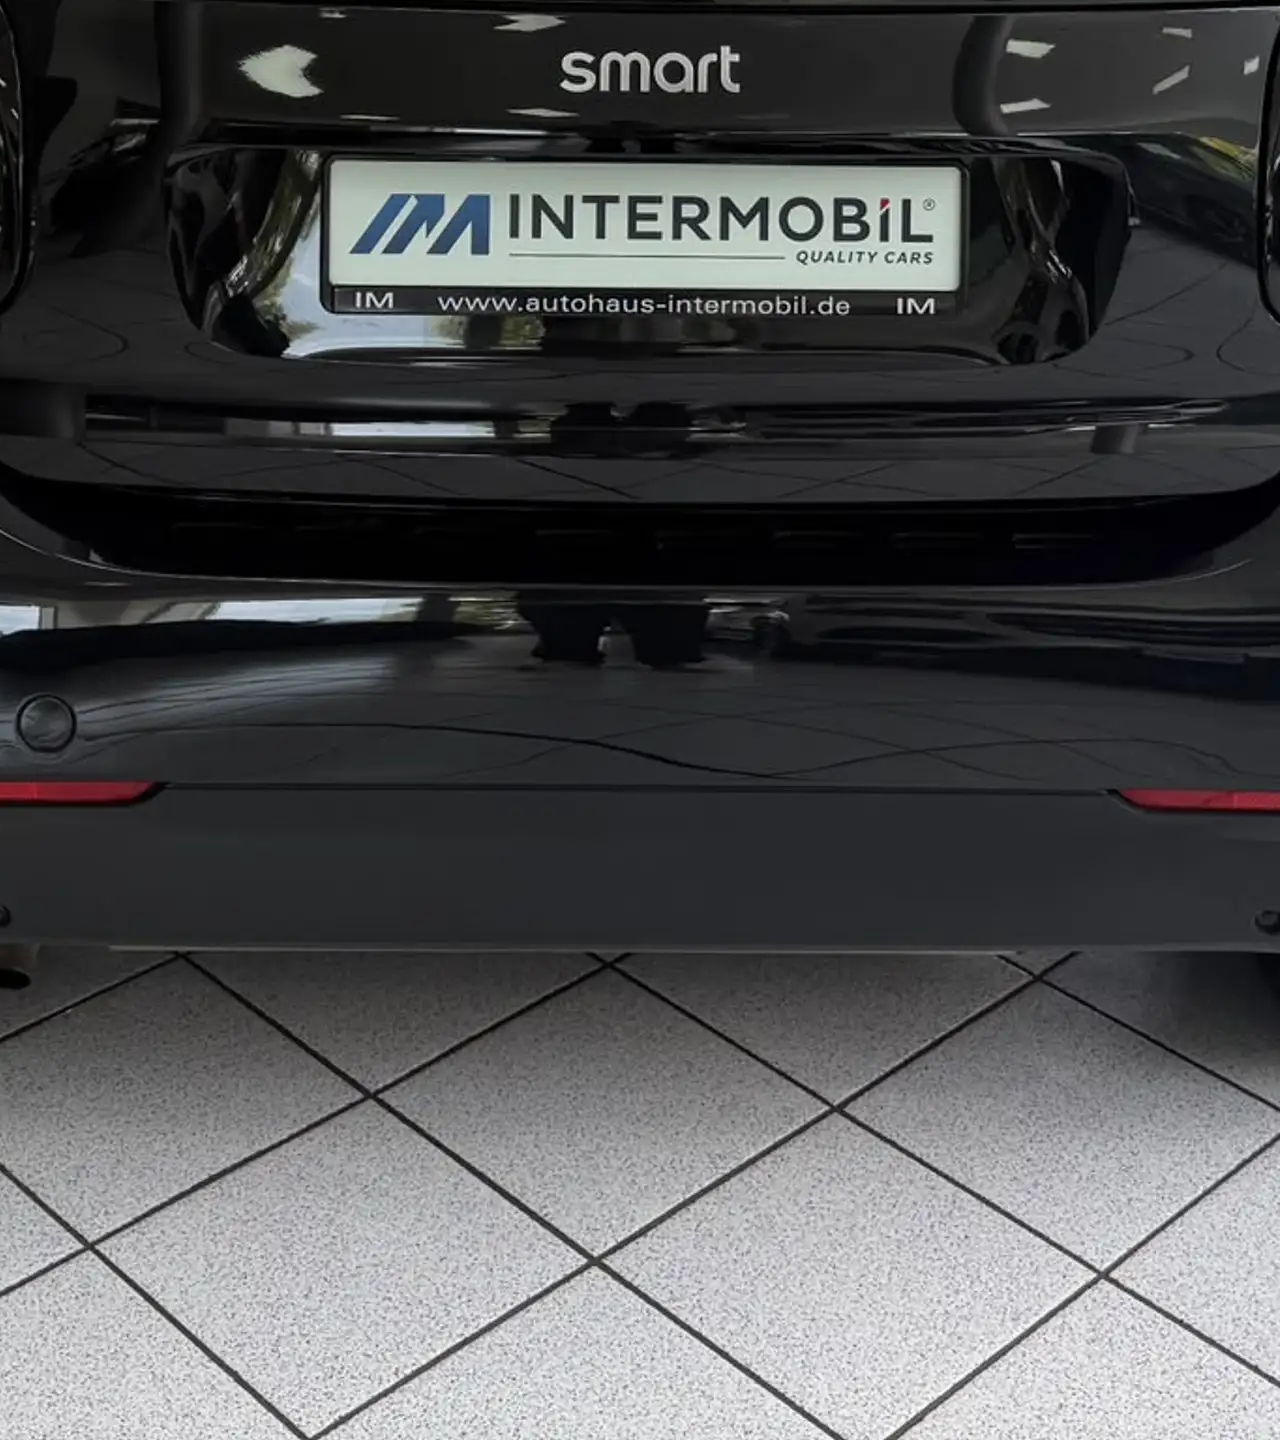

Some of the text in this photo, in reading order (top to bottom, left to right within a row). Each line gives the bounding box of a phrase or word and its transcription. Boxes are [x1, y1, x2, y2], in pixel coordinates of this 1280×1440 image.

[560, 45, 741, 93] smart
[795, 250, 934, 265] QUALITY CARS
[354, 291, 936, 317] IM www.autohaus-intermobil.de IM
